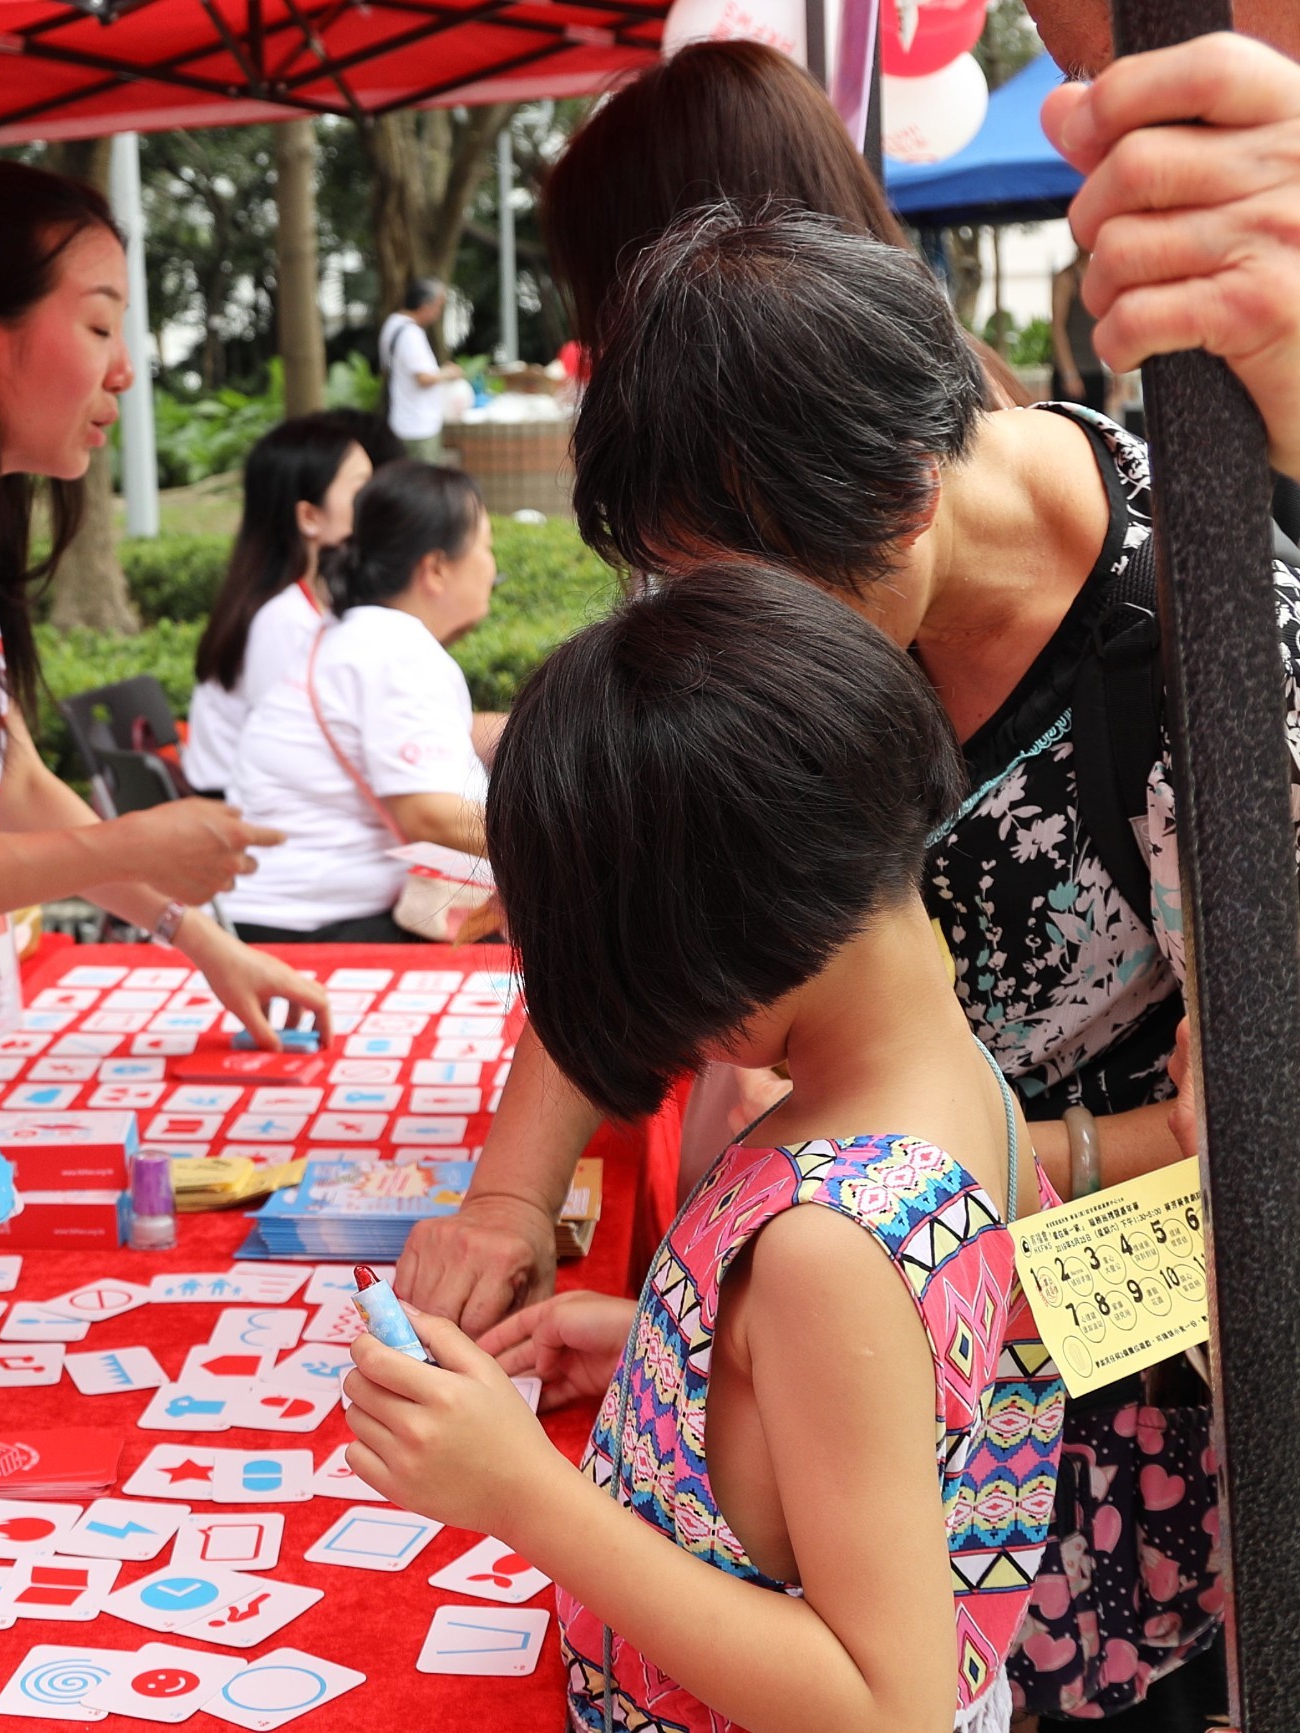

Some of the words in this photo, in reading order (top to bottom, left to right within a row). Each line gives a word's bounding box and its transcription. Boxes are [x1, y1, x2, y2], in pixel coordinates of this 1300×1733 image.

[1185, 1207, 1199, 1231] 6
[1151, 1220, 1166, 1244] 5
[1120, 1233, 1133, 1256] 4
[1055, 1258, 1070, 1281] 2
[1084, 1247, 1100, 1270] 3
[1030, 1268, 1042, 1291] 1
[1160, 1266, 1180, 1289] 10
[1127, 1279, 1143, 1303] 9
[1066, 1303, 1080, 1326] 7
[1095, 1292, 1111, 1316] 8
